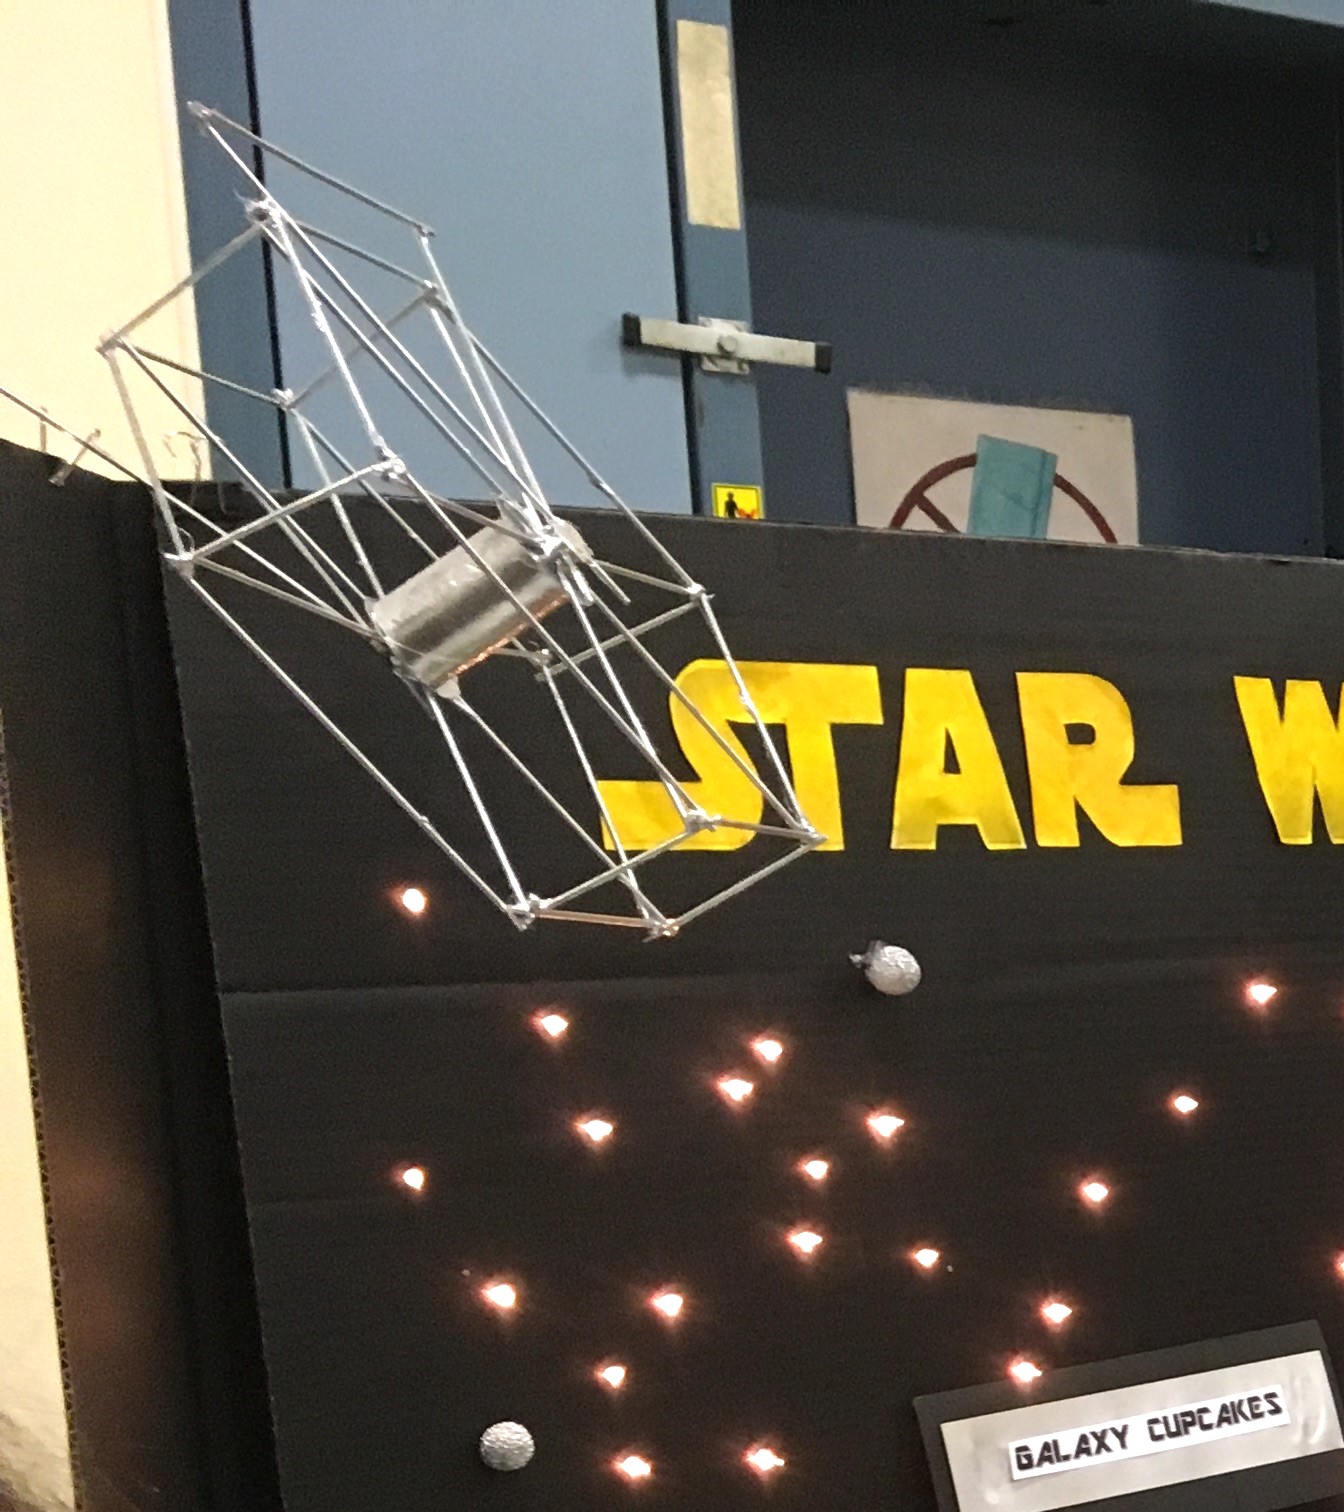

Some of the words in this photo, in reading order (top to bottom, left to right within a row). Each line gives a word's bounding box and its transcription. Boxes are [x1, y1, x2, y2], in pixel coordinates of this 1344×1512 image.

[599, 658, 1183, 853] STAR
[1016, 1425, 1126, 1470] GALAXY
[1148, 1393, 1281, 1441] CUPCAKES
